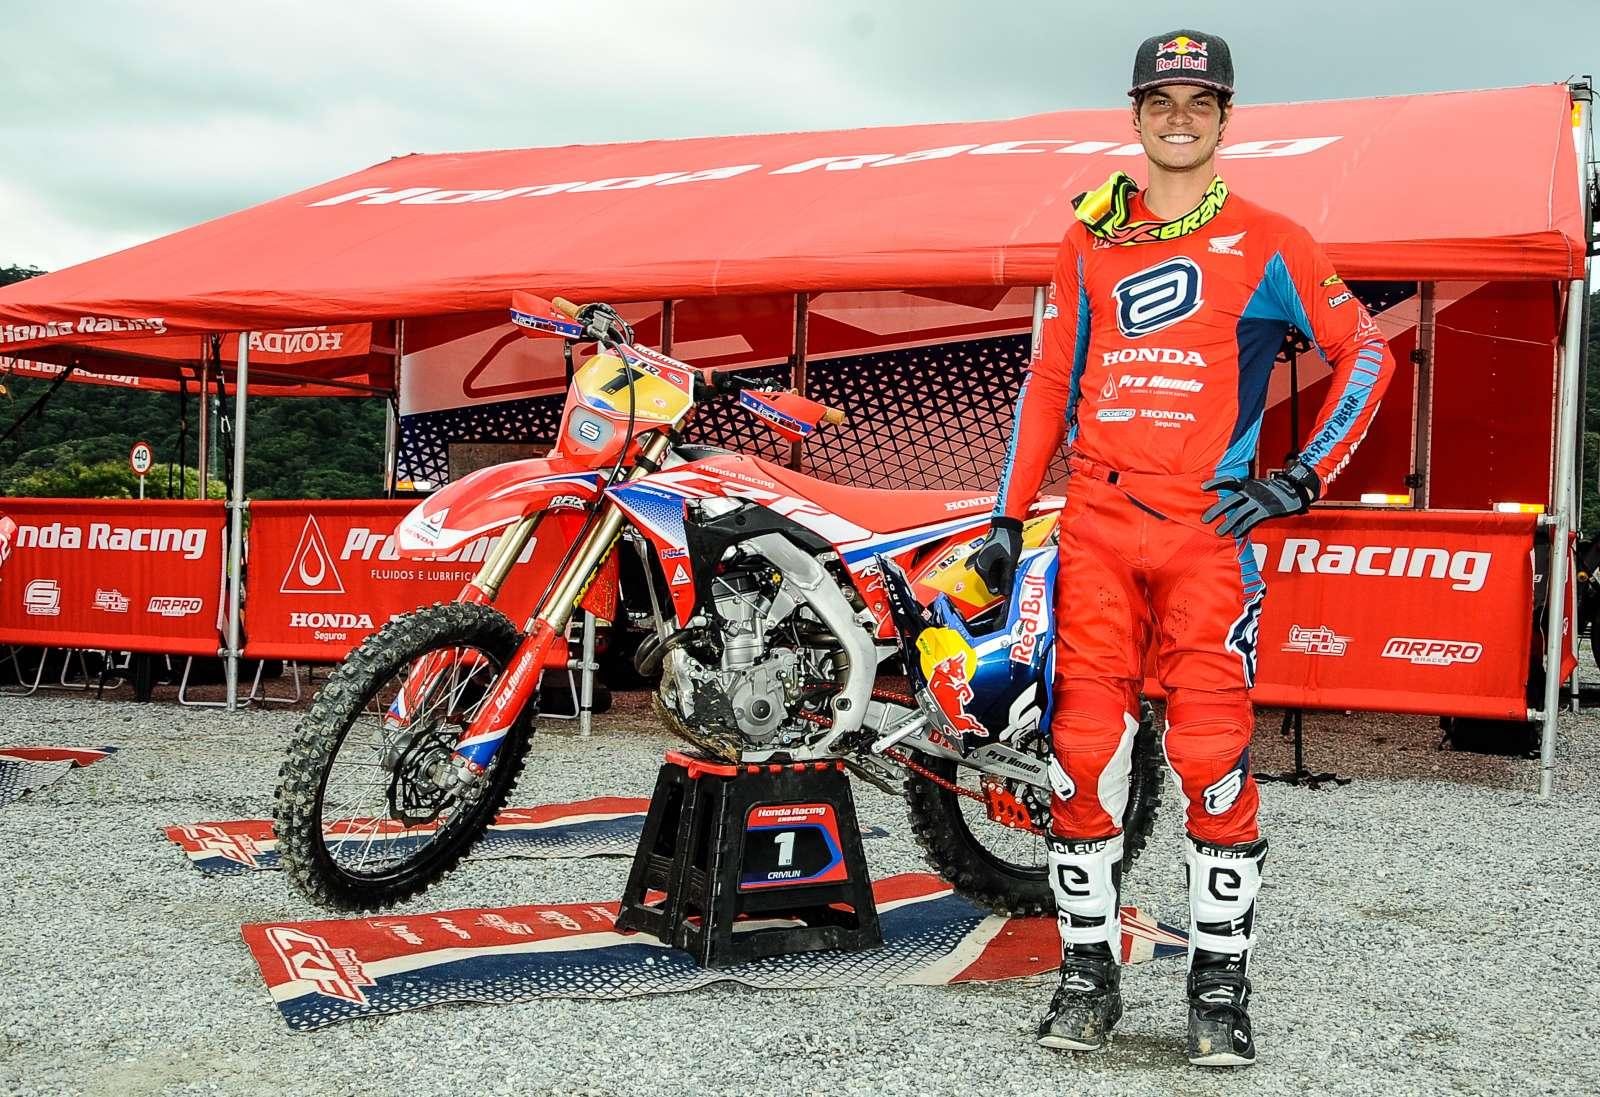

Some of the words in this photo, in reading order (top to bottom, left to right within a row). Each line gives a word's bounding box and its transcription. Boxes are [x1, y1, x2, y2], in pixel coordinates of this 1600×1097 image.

[1156, 55, 1180, 71] Red
[1182, 55, 1207, 71] Bull
[306, 164, 762, 206] Honda
[1207, 247, 1244, 256] HONDA
[77, 316, 168, 335] Racing
[1102, 347, 1207, 367] HONDA
[1118, 375, 1147, 388] Pro
[1147, 376, 1204, 393] Honda
[1140, 409, 1197, 422] HONDA
[134, 449, 148, 461] 40
[700, 464, 738, 479] Honda
[738, 472, 776, 488] Racing
[16, 522, 82, 549] nda
[88, 523, 207, 560] Racing
[340, 528, 401, 561] Pro
[1277, 538, 1492, 592] Racing
[371, 569, 414, 581] FLUIDOS
[418, 570, 424, 581] E
[427, 570, 478, 583] LUBRIFICA
[1020, 574, 1046, 615] Bull
[289, 613, 374, 629] HONDA
[314, 631, 347, 642] Seguros
[1011, 617, 1038, 663] Red
[1290, 625, 1335, 643] tech
[495, 687, 513, 711] Pro
[507, 650, 533, 690] Honda
[985, 750, 1006, 764] Pro
[1007, 755, 1042, 774] Honda
[758, 808, 791, 817] Honda
[792, 807, 826, 816] Racing
[774, 831, 796, 866] 1
